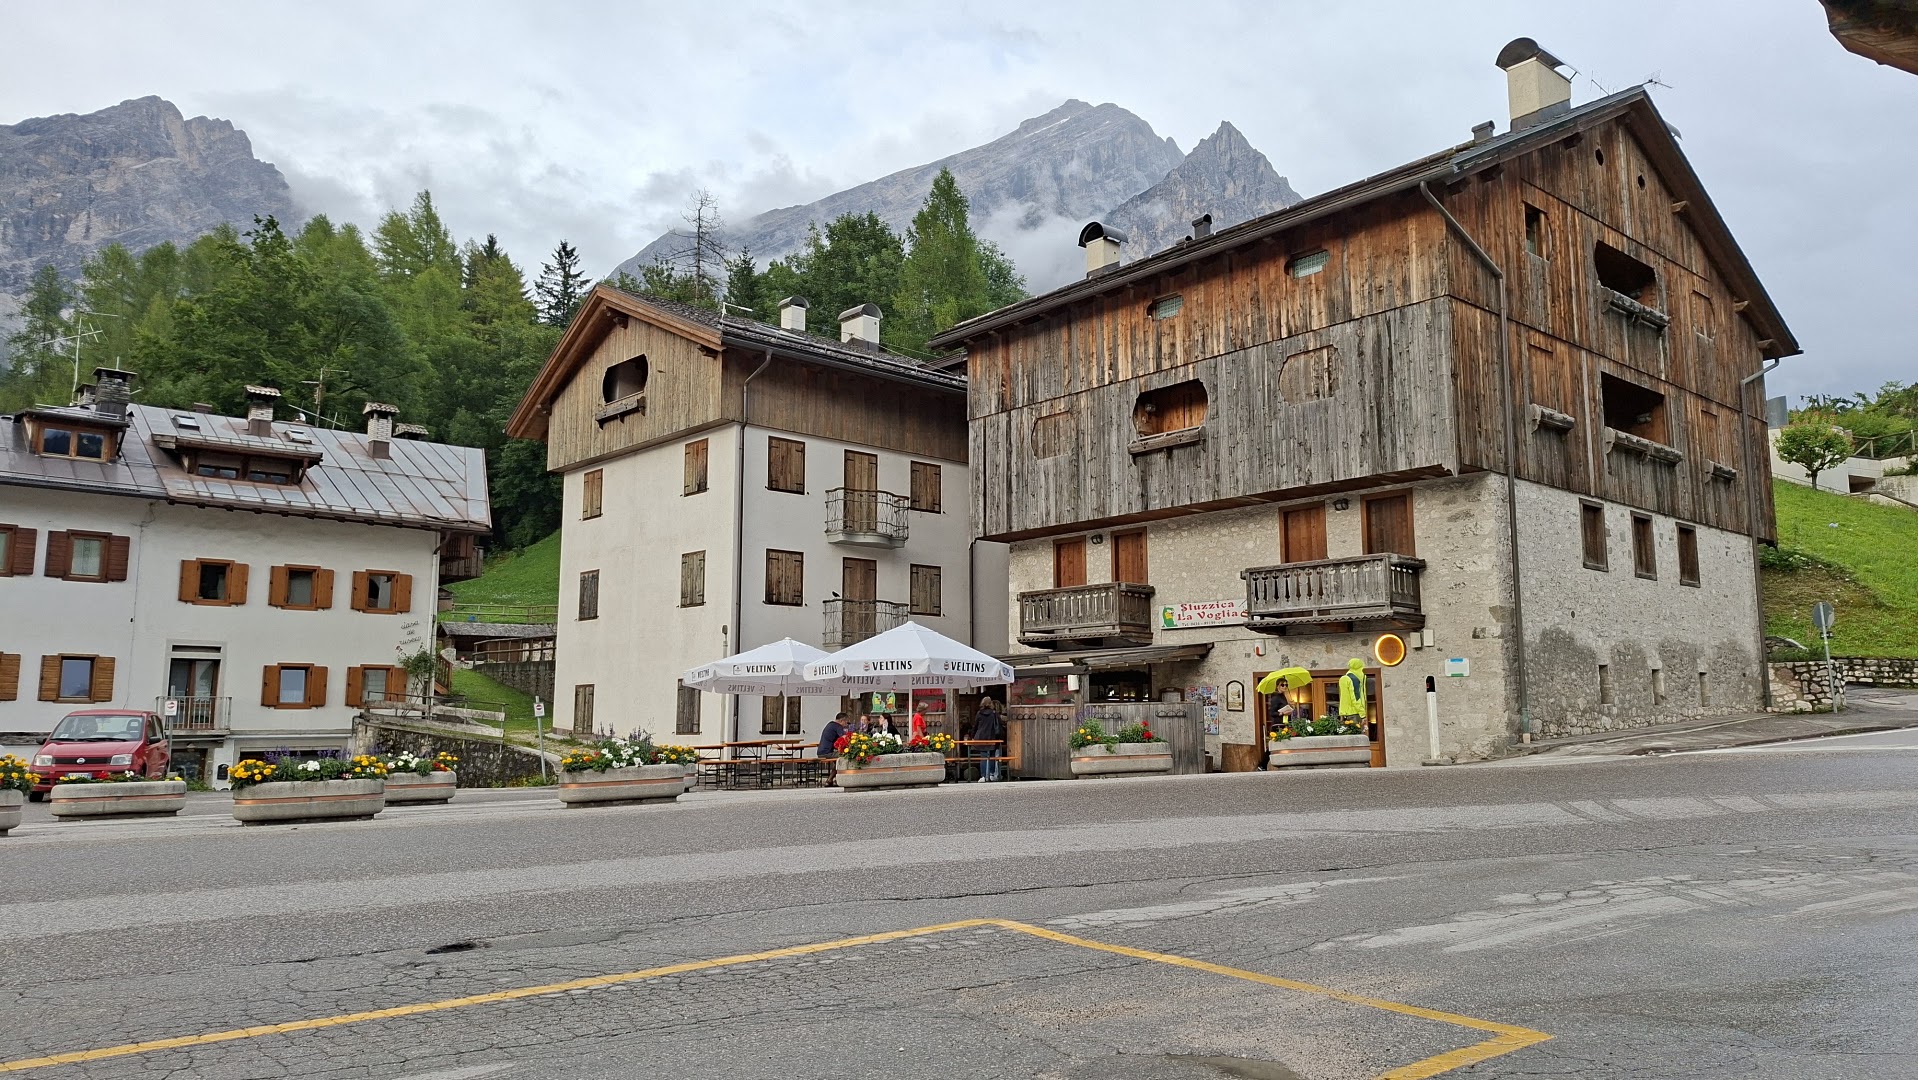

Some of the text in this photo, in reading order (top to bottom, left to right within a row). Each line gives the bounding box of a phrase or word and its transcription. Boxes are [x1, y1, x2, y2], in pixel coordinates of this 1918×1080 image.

[1180, 601, 1235, 612] Stuzzica
[1177, 609, 1238, 621] La Voglia
[746, 664, 776, 673] VELTINS
[818, 664, 838, 676] VELTINS
[872, 660, 913, 671] VELTINS
[951, 661, 985, 673] VELTINS
